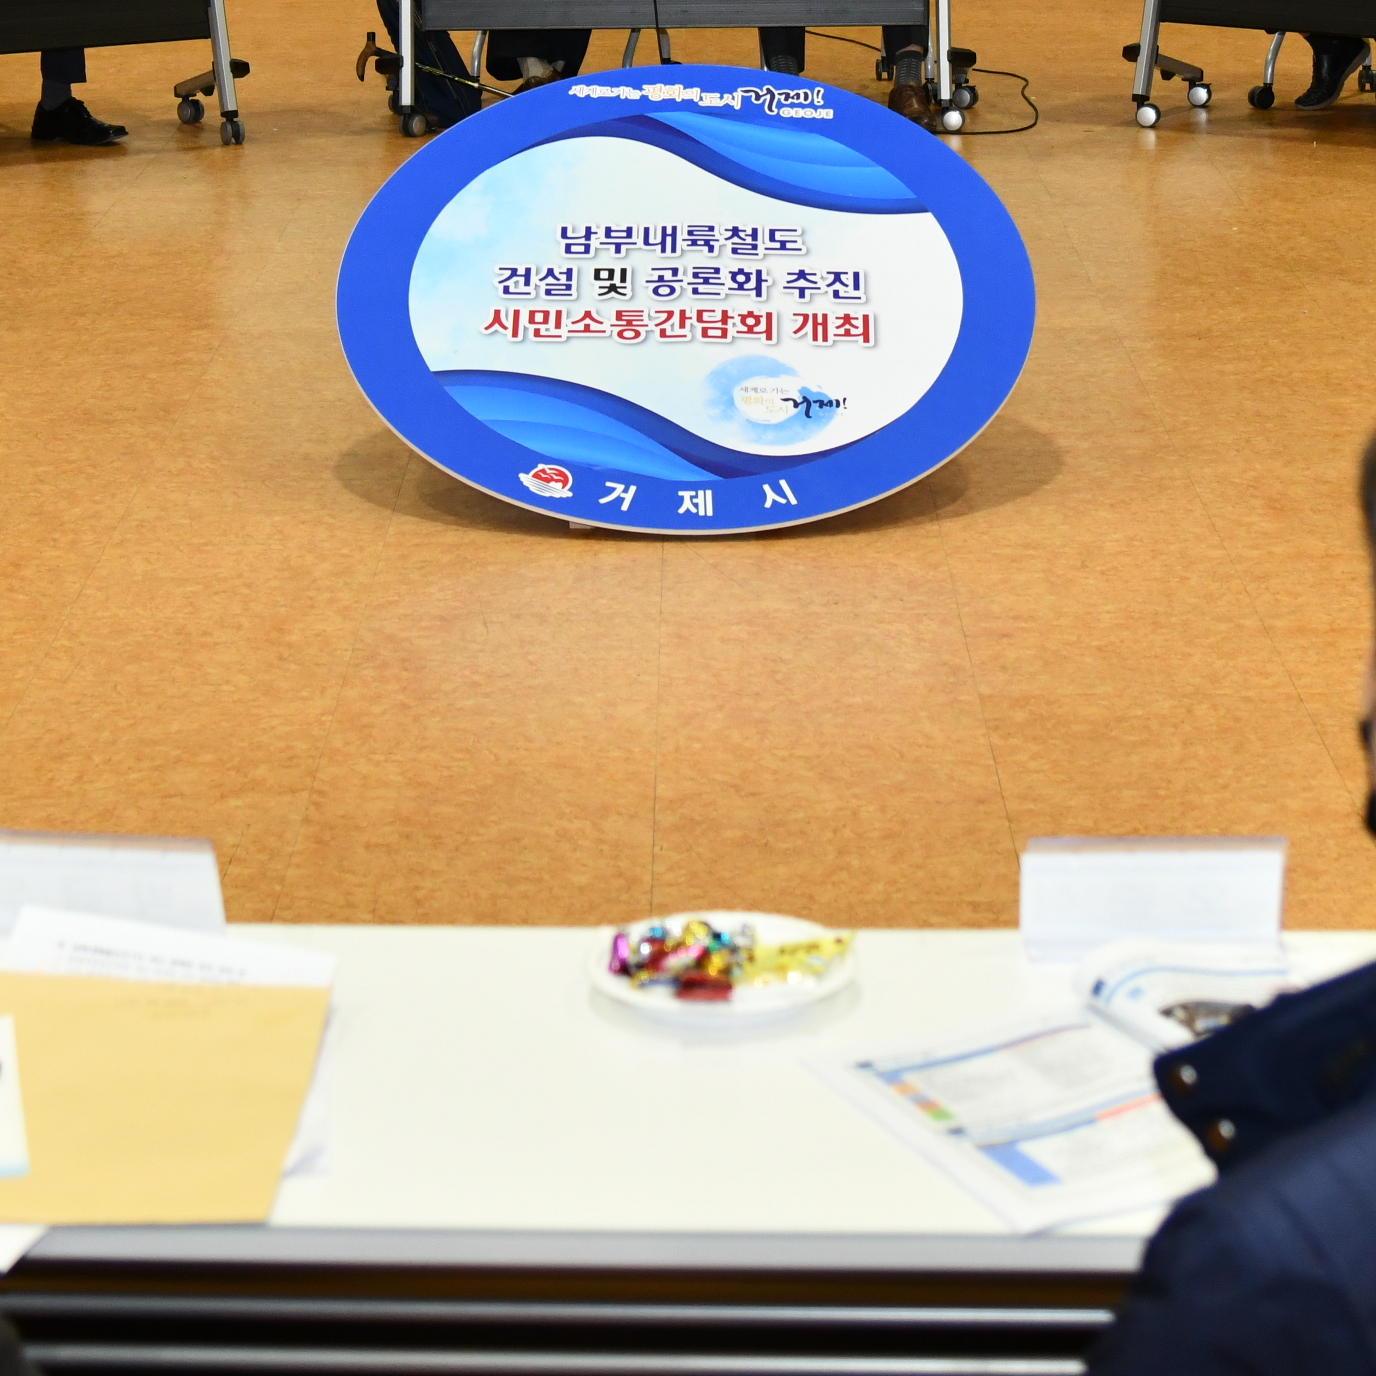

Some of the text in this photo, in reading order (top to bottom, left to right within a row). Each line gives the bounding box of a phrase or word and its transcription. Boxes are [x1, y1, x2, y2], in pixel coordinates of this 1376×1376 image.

[699, 91, 742, 109] 도시
[559, 224, 804, 257] 남부내륙철도
[497, 266, 866, 303] 건설 및 공론화 추진
[481, 308, 873, 345] 시민소통간담회 개최
